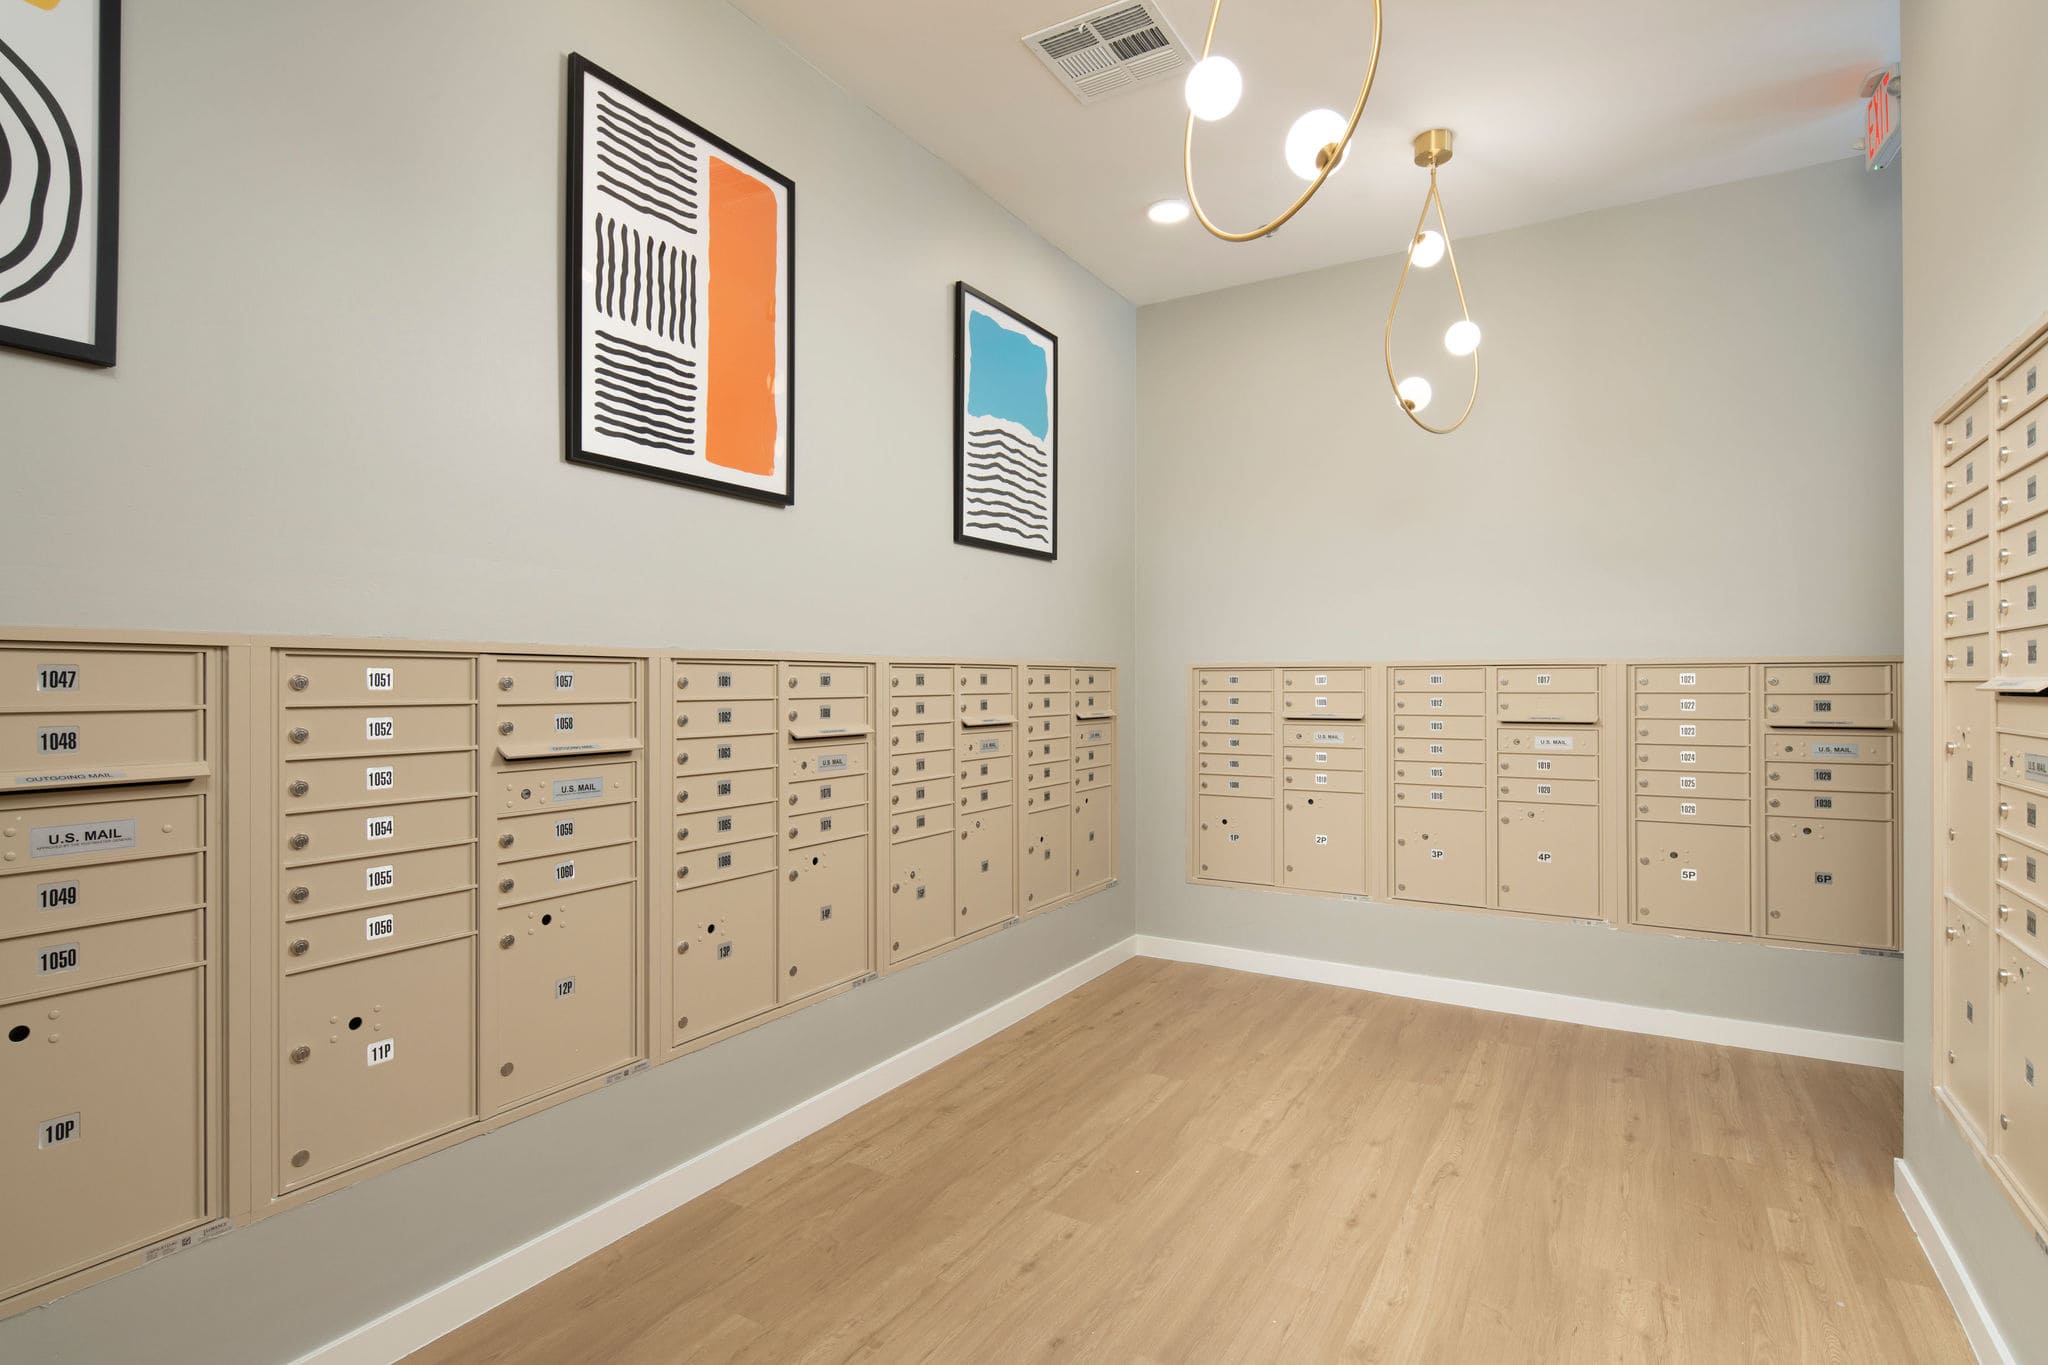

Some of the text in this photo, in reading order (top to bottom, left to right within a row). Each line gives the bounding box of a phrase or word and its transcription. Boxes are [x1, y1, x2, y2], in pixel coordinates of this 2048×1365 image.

[40, 670, 76, 688] 1047
[369, 673, 391, 688] 1051
[556, 675, 573, 688] 1057
[1681, 676, 1694, 684] 1021
[1815, 675, 1830, 684] 1027
[1681, 701, 1695, 710] 1022
[369, 722, 392, 737] 1052
[556, 717, 574, 730] 1058
[1681, 727, 1695, 736] 1023
[40, 732, 76, 750] 1048
[1681, 753, 1695, 762] 1024
[2037, 762, 2047, 773] MAIL
[26, 774, 86, 782] OUTGOING
[369, 771, 392, 787] 1053
[1681, 779, 1696, 788] 1025
[561, 785, 576, 793] U.S.
[1681, 805, 1696, 814] 1026
[369, 820, 393, 837] 1054
[556, 823, 574, 836] 1059
[48, 828, 122, 845] U.S. MAIL
[1432, 850, 1443, 858] 3P
[369, 870, 392, 887] 1055
[556, 865, 574, 880] 1060
[1682, 871, 1696, 879] 5P
[1816, 875, 1832, 883] 6P
[40, 886, 76, 908] 1049
[369, 919, 392, 938] 1056
[720, 946, 731, 958] 13P
[41, 948, 76, 972] 1050
[558, 981, 573, 997] 12P
[372, 1044, 391, 1062] 11P
[46, 1120, 74, 1144] 10P
